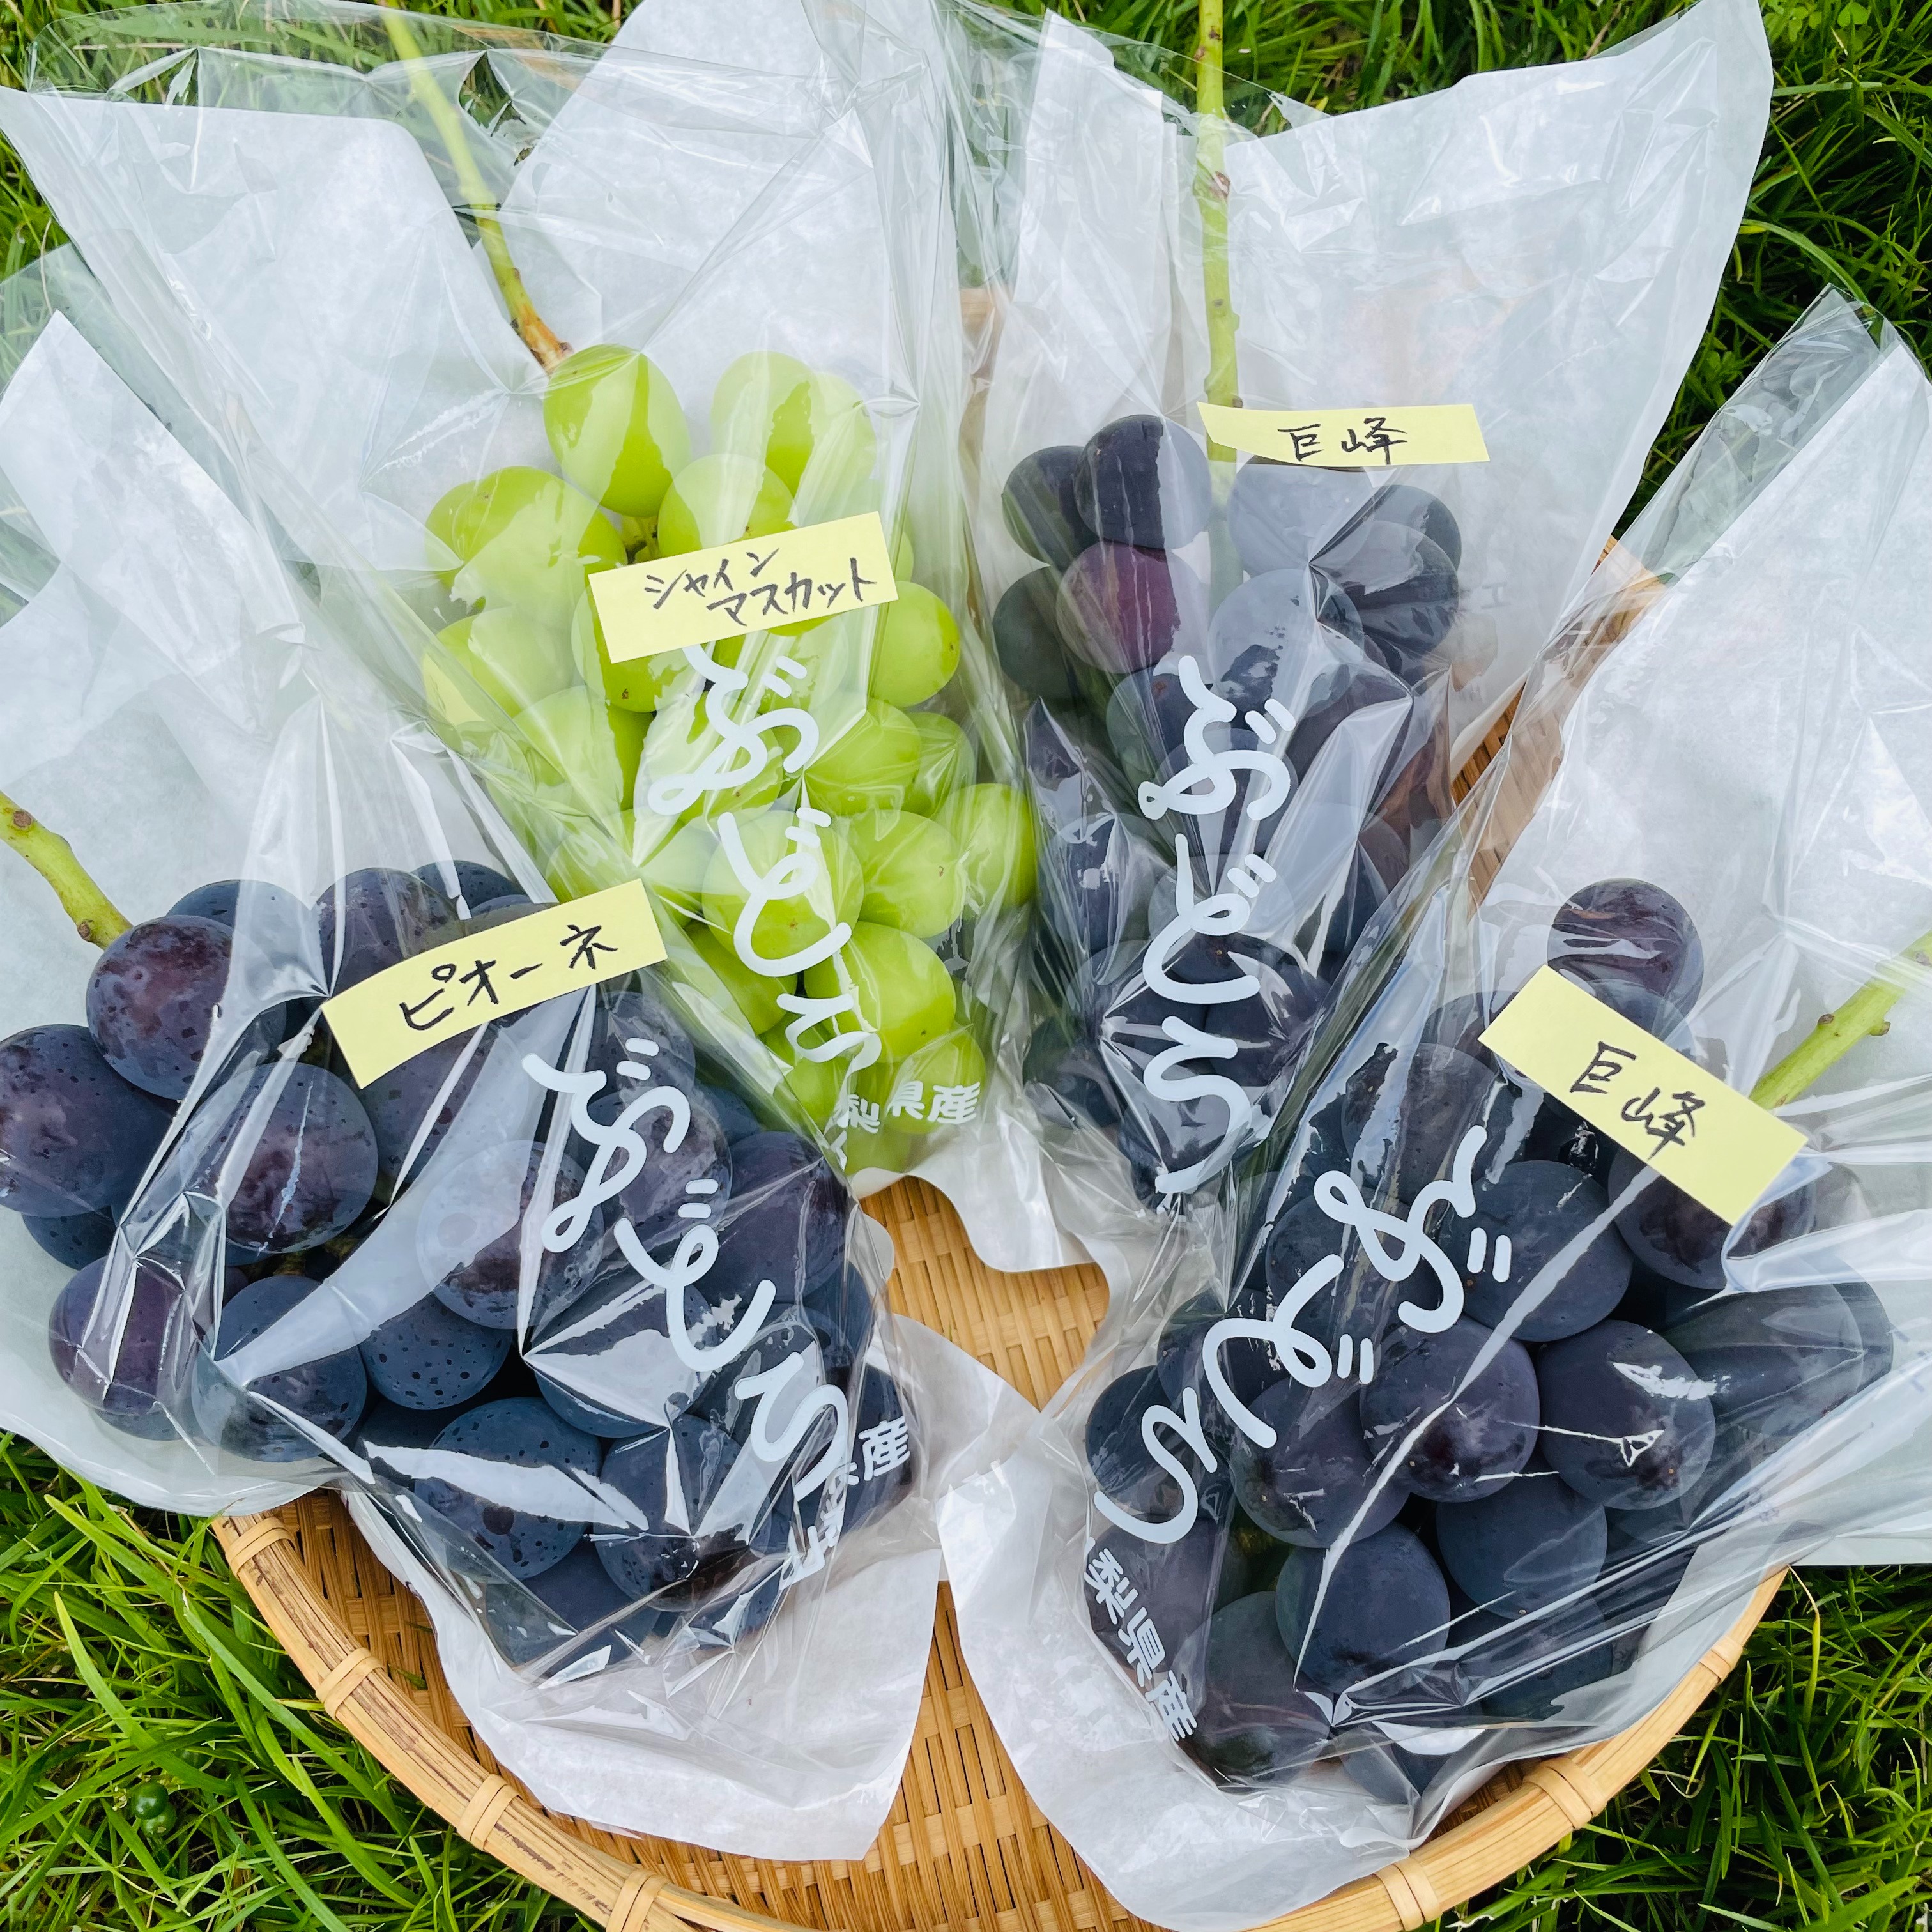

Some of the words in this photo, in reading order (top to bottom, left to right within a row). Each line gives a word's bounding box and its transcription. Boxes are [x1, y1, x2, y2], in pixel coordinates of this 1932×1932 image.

[1277, 417, 1409, 466] 巨峰
[644, 548, 780, 610] シャイン
[706, 557, 877, 627] マスカット
[647, 644, 881, 1100] ぶどう
[1138, 656, 1296, 1194] ぶどう
[399, 924, 618, 1031] ピオーネ
[1570, 1041, 1706, 1160] 巨峰
[521, 1038, 848, 1500] ぶどう
[1094, 1125, 1512, 1544] ぶどう
[1084, 1536, 1198, 1742] 梨県産
